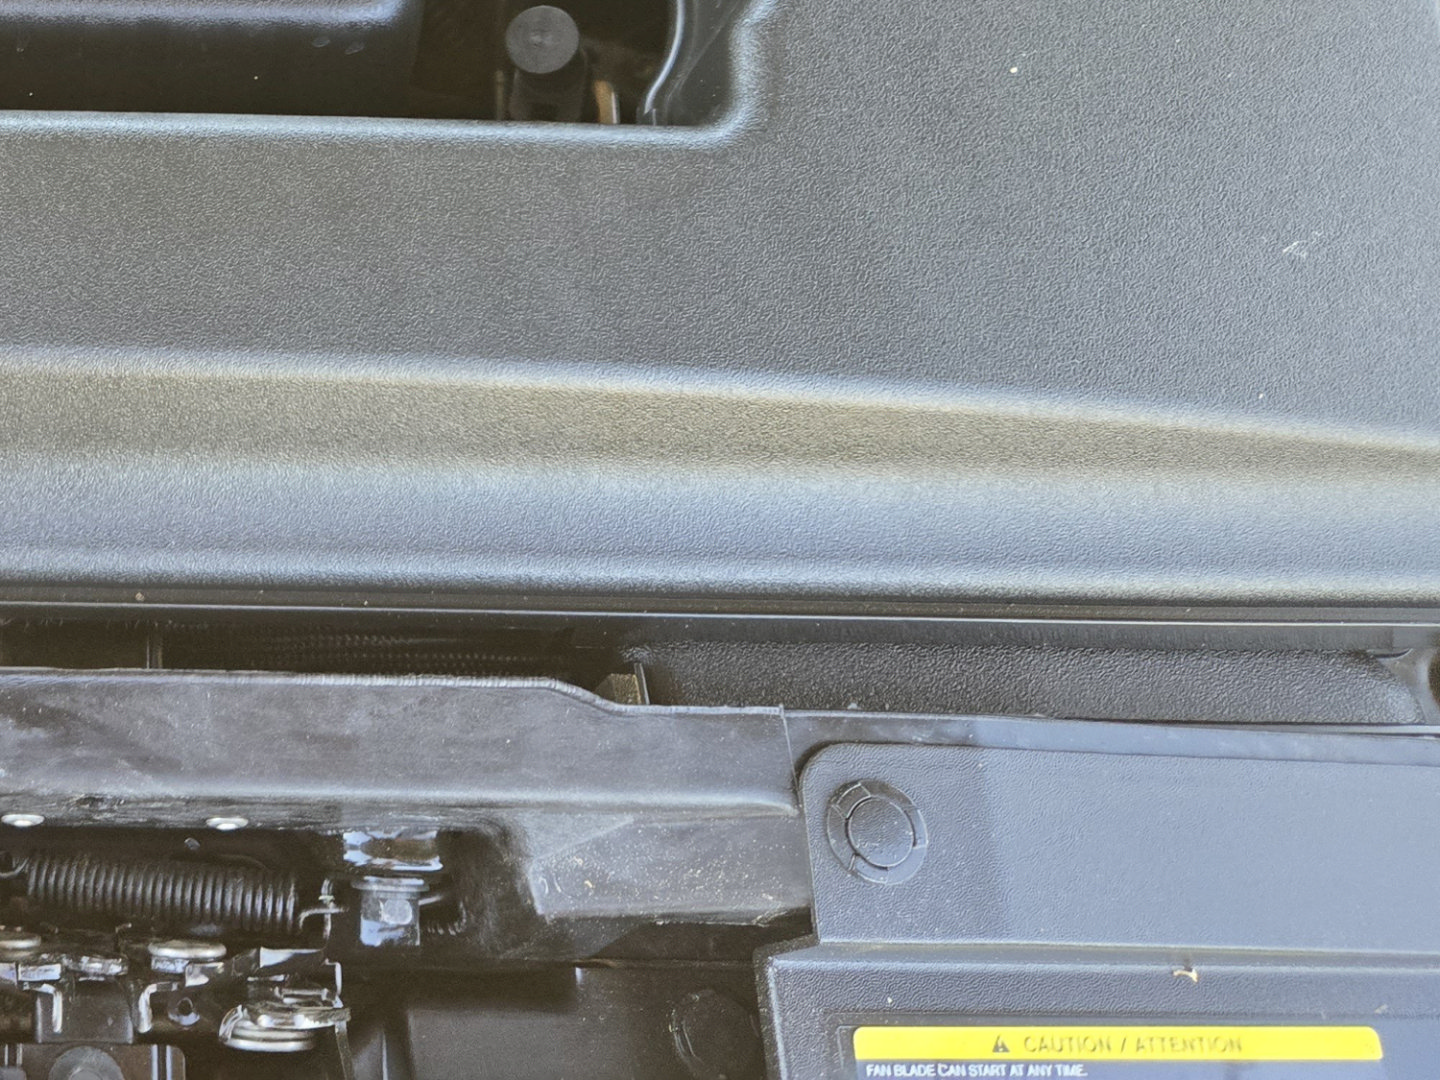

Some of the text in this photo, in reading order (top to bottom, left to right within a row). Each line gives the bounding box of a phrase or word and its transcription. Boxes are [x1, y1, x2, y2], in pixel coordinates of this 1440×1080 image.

[1024, 1035, 1112, 1052] CAUTION
[1135, 1035, 1243, 1053] ATTENTION
[866, 1063, 891, 1077] FAN
[894, 1063, 936, 1077] BLADE
[937, 1063, 966, 1077] CAN
[968, 1063, 1008, 1077] START
[1010, 1063, 1024, 1077] AT
[1027, 1063, 1052, 1077] ANY
